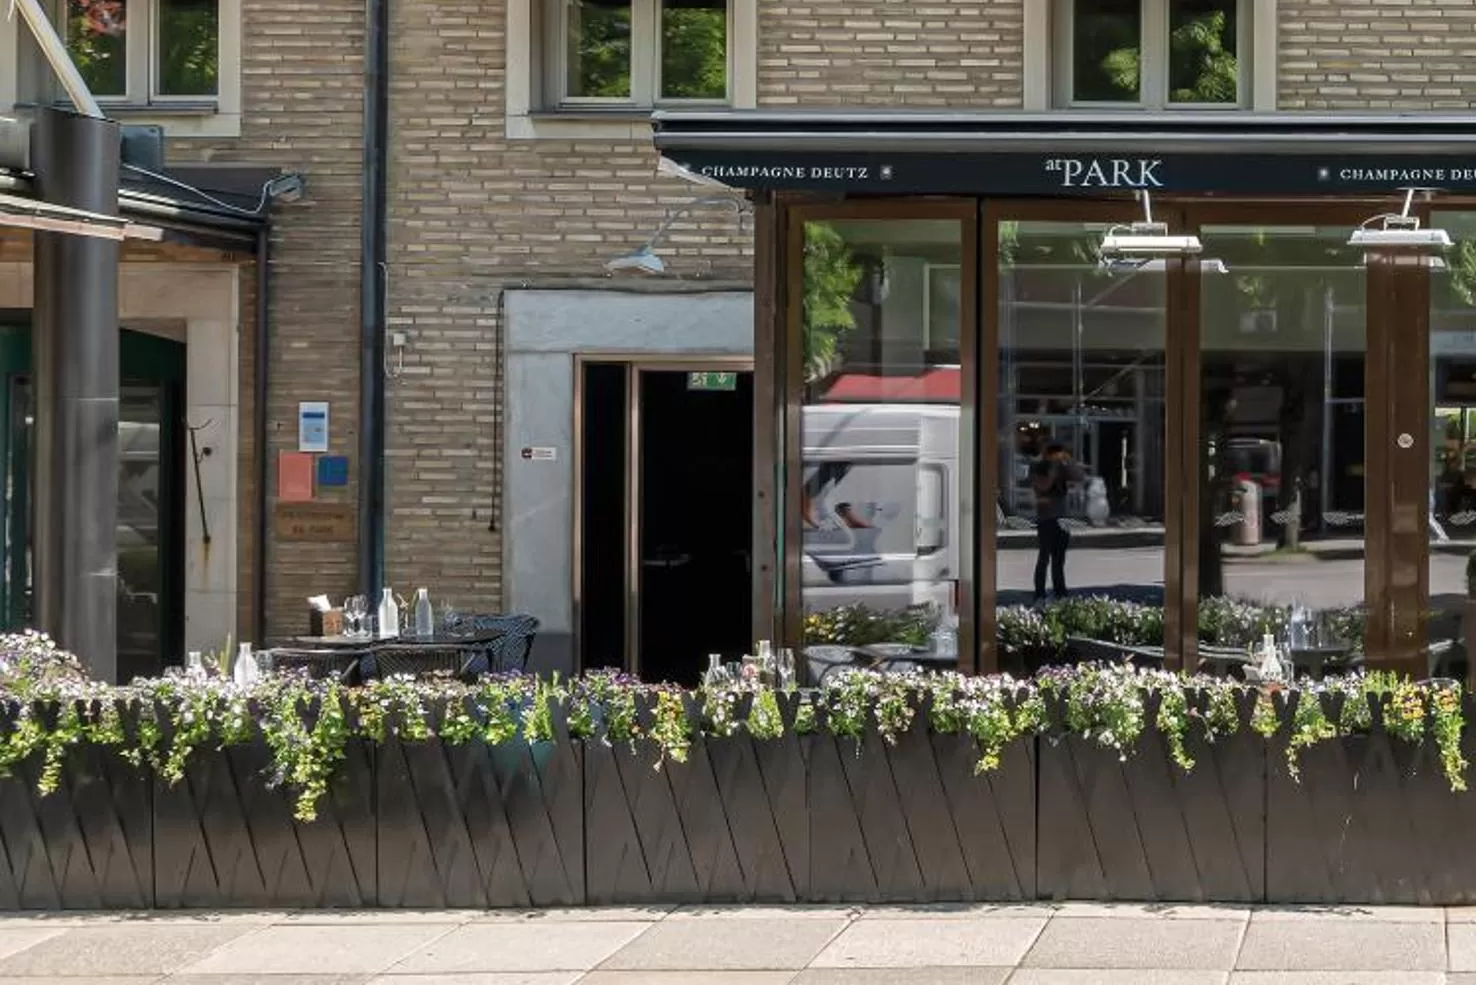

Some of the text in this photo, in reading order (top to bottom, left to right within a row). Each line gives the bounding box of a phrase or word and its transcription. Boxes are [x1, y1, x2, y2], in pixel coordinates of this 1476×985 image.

[702, 166, 869, 179] CHAMPAGNE DEUTZ
[1340, 168, 1445, 181] CHAMPAGNE
